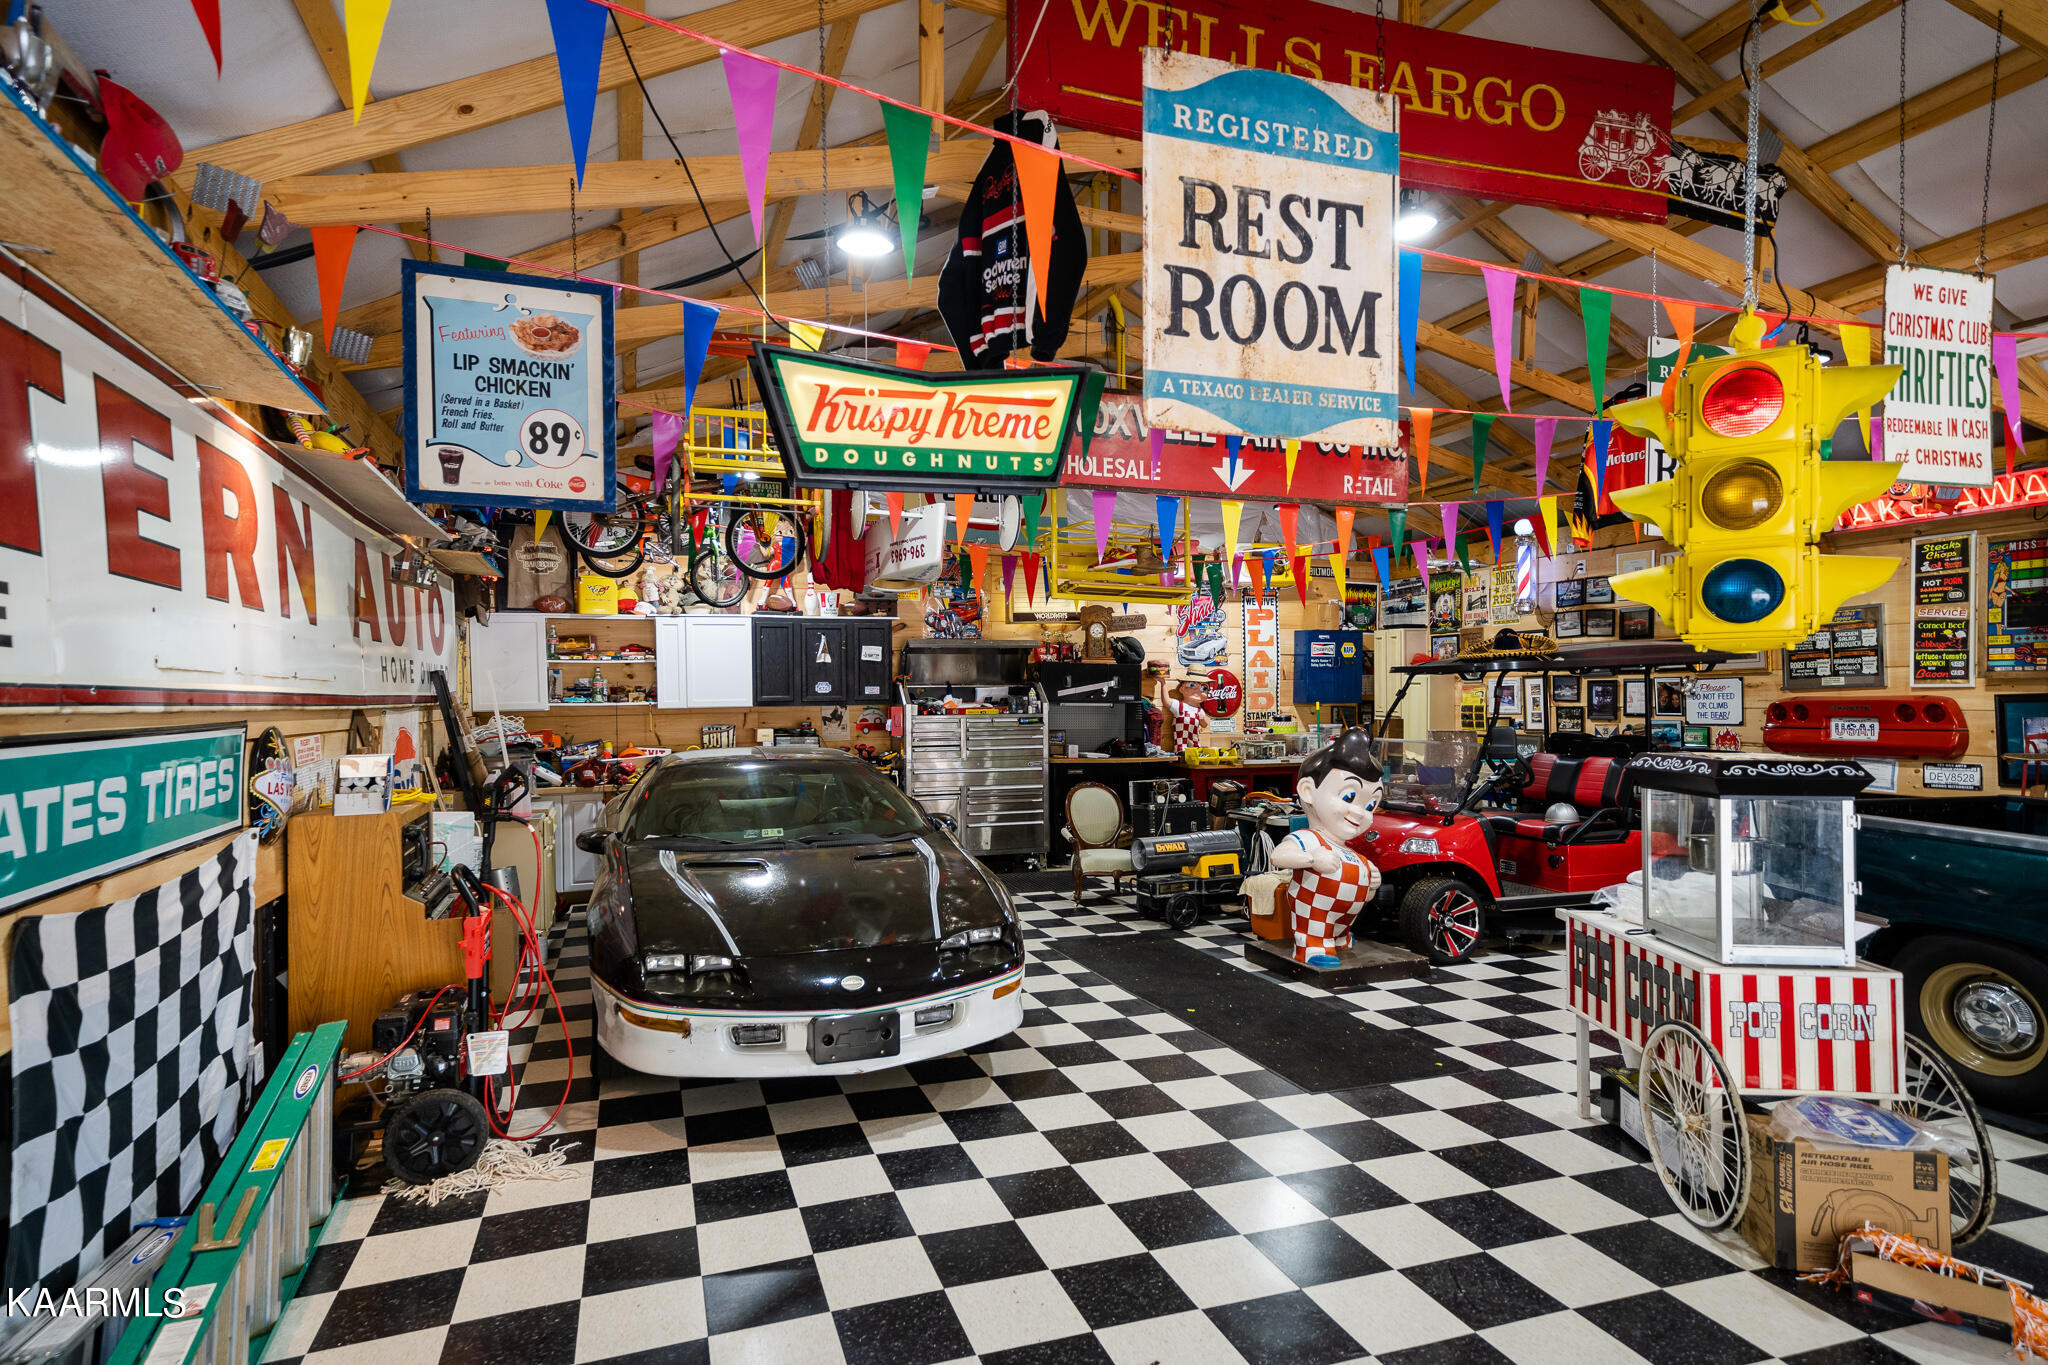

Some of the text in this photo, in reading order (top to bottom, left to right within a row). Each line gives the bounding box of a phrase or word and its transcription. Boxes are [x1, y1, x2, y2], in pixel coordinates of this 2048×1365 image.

[1345, 48, 1566, 133] FARGO
[1173, 103, 1374, 161] REGISTERED
[1178, 175, 1364, 271] REST
[1913, 283, 1968, 306] WE GIVE
[1163, 264, 1382, 358] ROOM
[438, 325, 506, 342] Featuring
[1888, 312, 1954, 342] CHRISTMAS
[453, 352, 575, 380] LIP SMACKIN'
[1887, 345, 1987, 409] THRIFTIES
[475, 376, 551, 398] CHICKEN
[1162, 377, 1382, 413] A TEXACO DEALER SERVICE
[440, 393, 472, 406] (Served
[475, 397, 483, 407] in
[493, 399, 525, 410] Basket)
[441, 406, 469, 418] French
[806, 383, 939, 445] Krispy
[934, 389, 1057, 441] Kreme
[442, 419, 504, 432] Roll and Butter
[1887, 417, 1989, 440] REDEEMABLE IN CASH
[1895, 449, 1983, 469] at CHRISTMAS
[536, 478, 564, 489] Coke
[890, 543, 926, 564] 396-6963
[1921, 541, 1961, 552] Steaks
[2010, 540, 2037, 551] MISS
[1926, 551, 1957, 560] Chops
[1923, 579, 1941, 587] HOT
[1245, 598, 1256, 606] WE
[1919, 609, 1967, 617] SERVICE
[1948, 621, 1966, 629] Beef
[1247, 608, 1275, 709] PLAID
[1343, 646, 1354, 654] NAPA
[380, 655, 415, 684] HOME
[1915, 668, 1949, 679] Bacon
[1700, 683, 1727, 691] Please
[1717, 692, 1735, 700] FEED
[1698, 702, 1708, 710] OR
[1246, 711, 1275, 721] STAMPS
[1697, 711, 1708, 719] THE
[1929, 771, 1976, 784] DEV8528
[140, 757, 235, 824] TIRES
[267, 782, 285, 795] LAS
[1574, 929, 1613, 1003] POP
[1729, 1000, 1877, 1041] POP CORN
[1800, 1152, 1870, 1163] RETRACTABLE
[1801, 1159, 1874, 1171] AIR HOSE REEL
[1779, 1151, 1787, 1187] CAMPBELL
